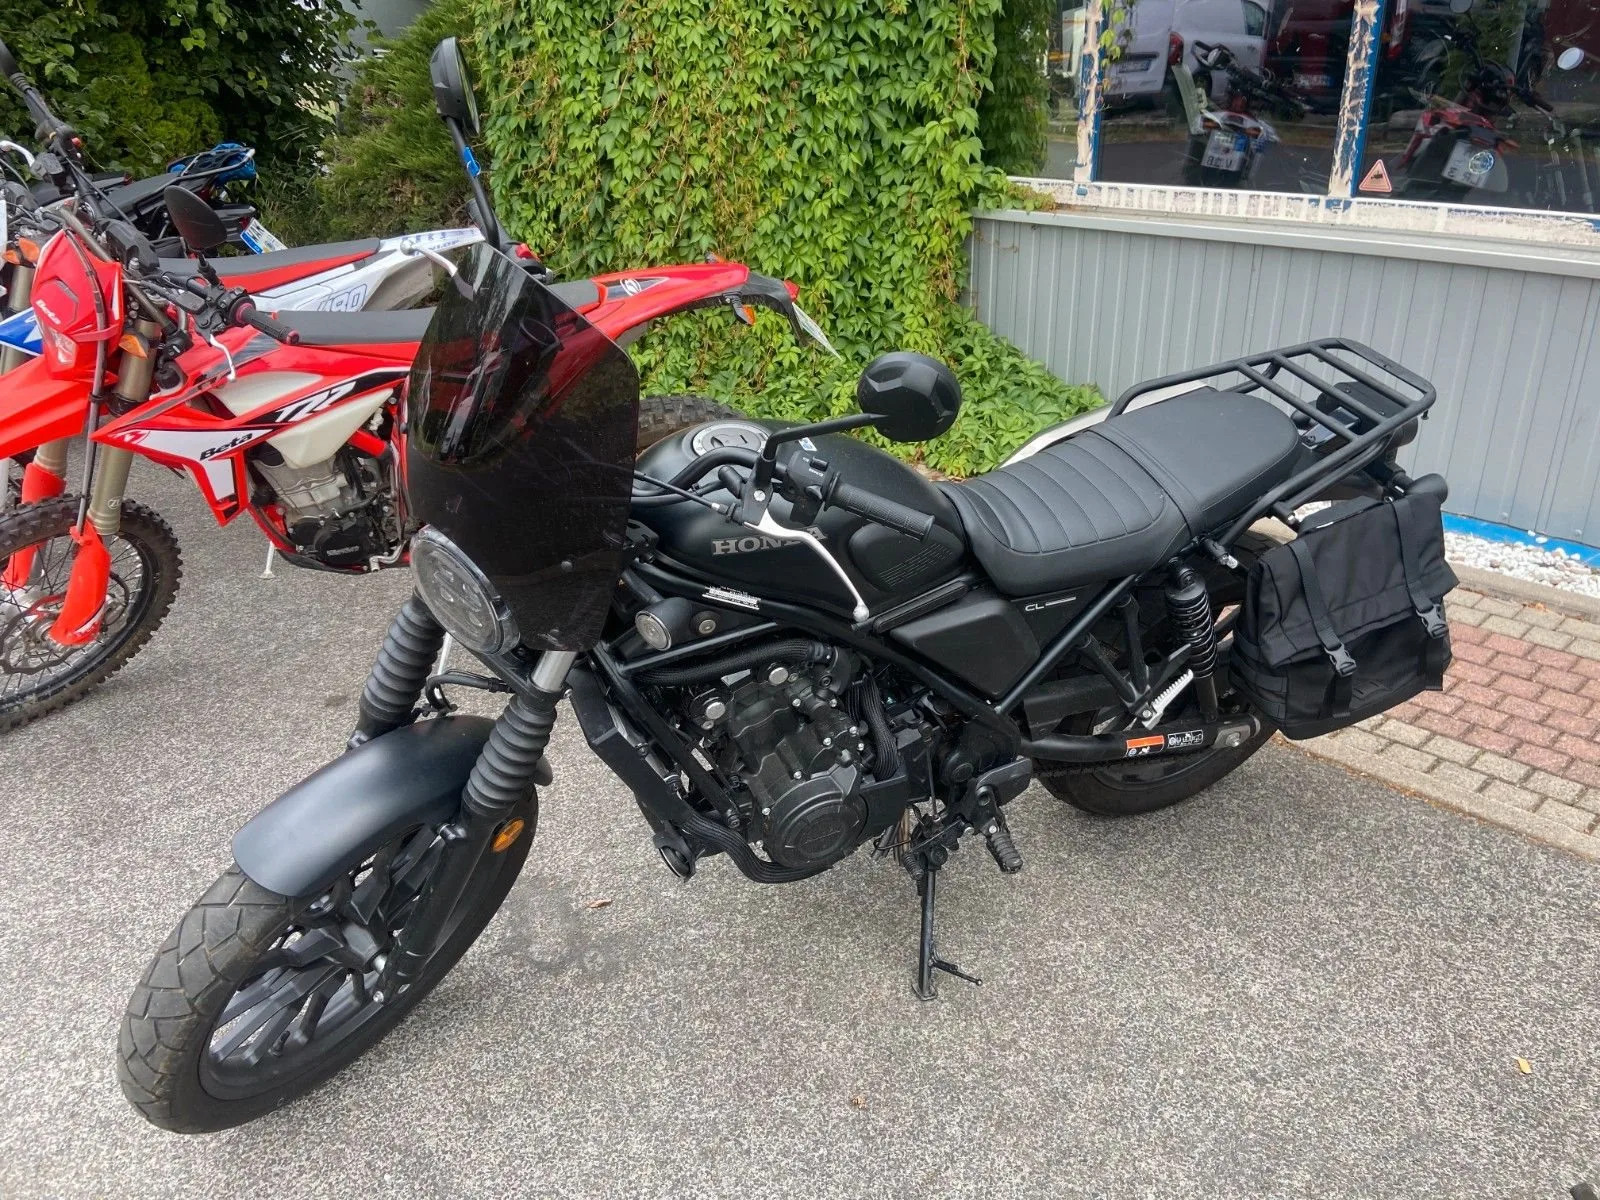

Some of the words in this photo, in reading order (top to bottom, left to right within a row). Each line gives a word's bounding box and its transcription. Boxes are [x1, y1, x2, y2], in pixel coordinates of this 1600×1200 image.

[35, 298, 62, 325] Beta
[200, 432, 253, 461] Beta
[711, 526, 828, 556] HONA
